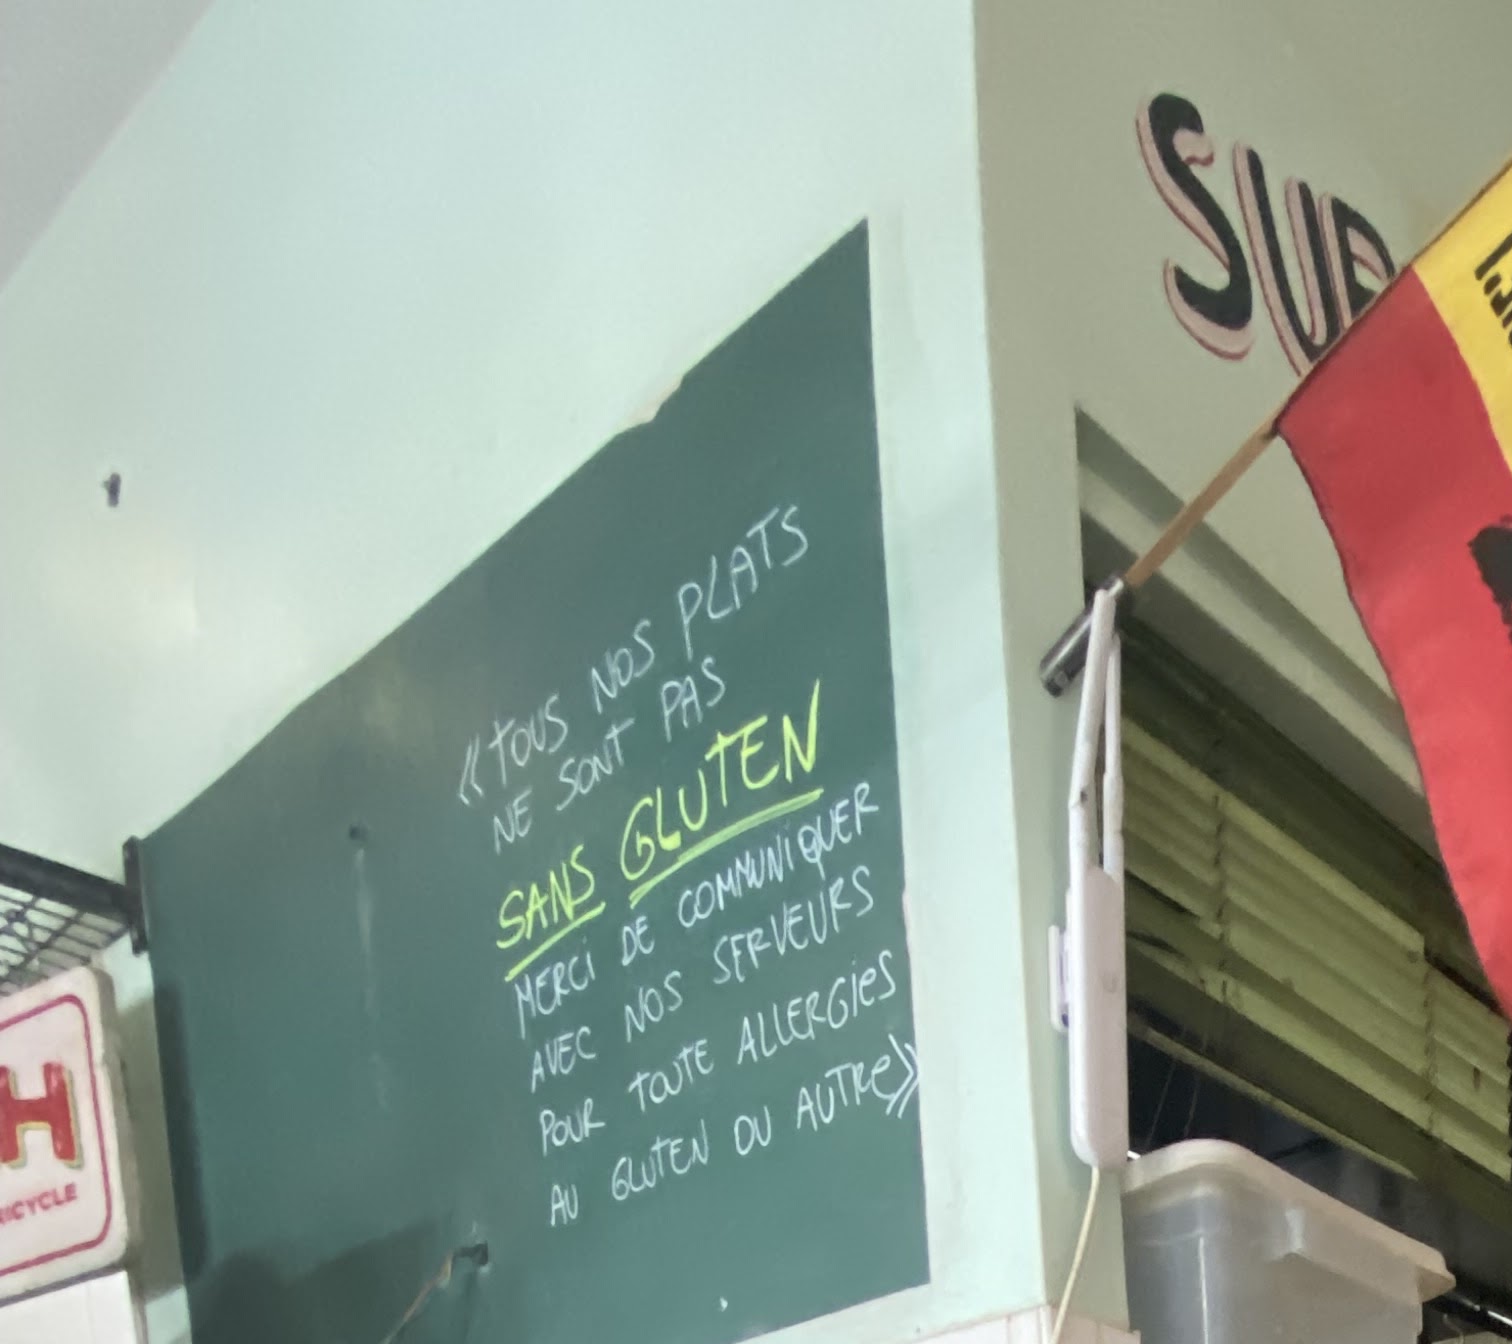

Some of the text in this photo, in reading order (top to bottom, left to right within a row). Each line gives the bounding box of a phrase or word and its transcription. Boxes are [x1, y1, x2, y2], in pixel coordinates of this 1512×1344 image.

[590, 618, 655, 715] NOS
[677, 504, 809, 662] PLATS
[492, 656, 727, 855] NE SONT PAS
[496, 678, 821, 949] SANS GLUTEN
[531, 864, 875, 1095] AVEC NOS SERVEURS
[621, 915, 656, 966] DE
[539, 1097, 607, 1158] POUR
[627, 1038, 715, 1113] TOUTE
[550, 1183, 580, 1228] AU
[611, 1117, 710, 1201] GLUTEN
[734, 1104, 772, 1156] OU
